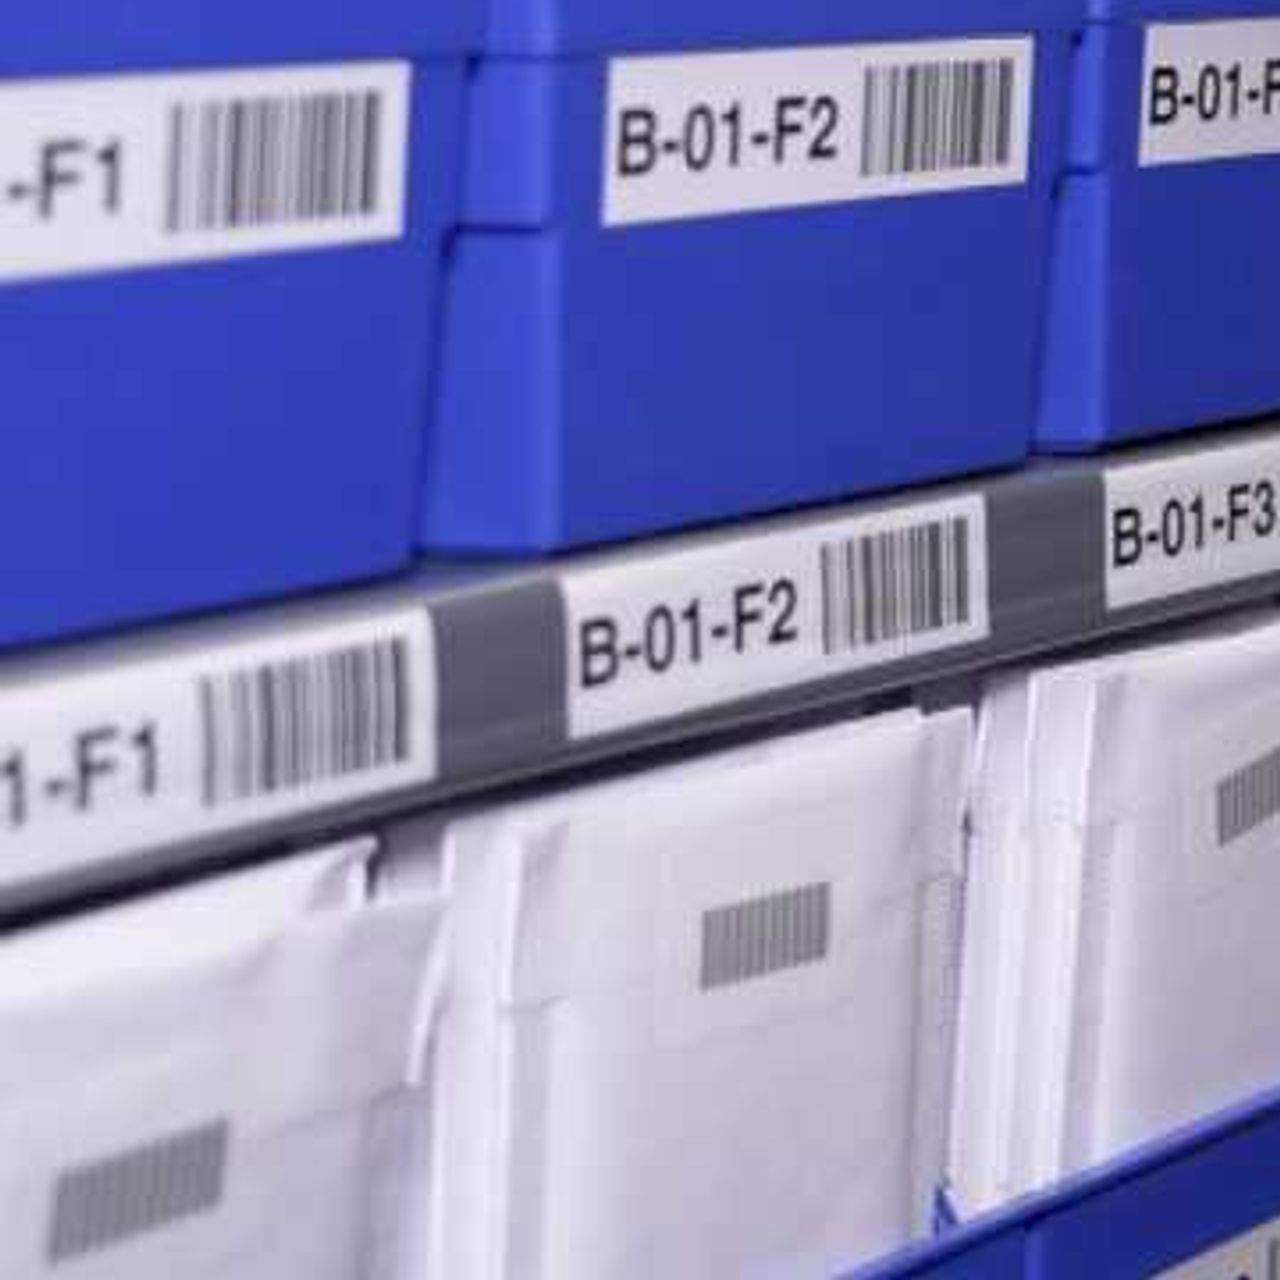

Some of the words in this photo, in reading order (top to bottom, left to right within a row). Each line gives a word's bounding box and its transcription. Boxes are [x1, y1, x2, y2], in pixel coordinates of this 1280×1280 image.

[617, 95, 839, 178] B-01-F2
[1112, 480, 1277, 569] B-01-F3
[580, 578, 799, 689] B-01-F2
